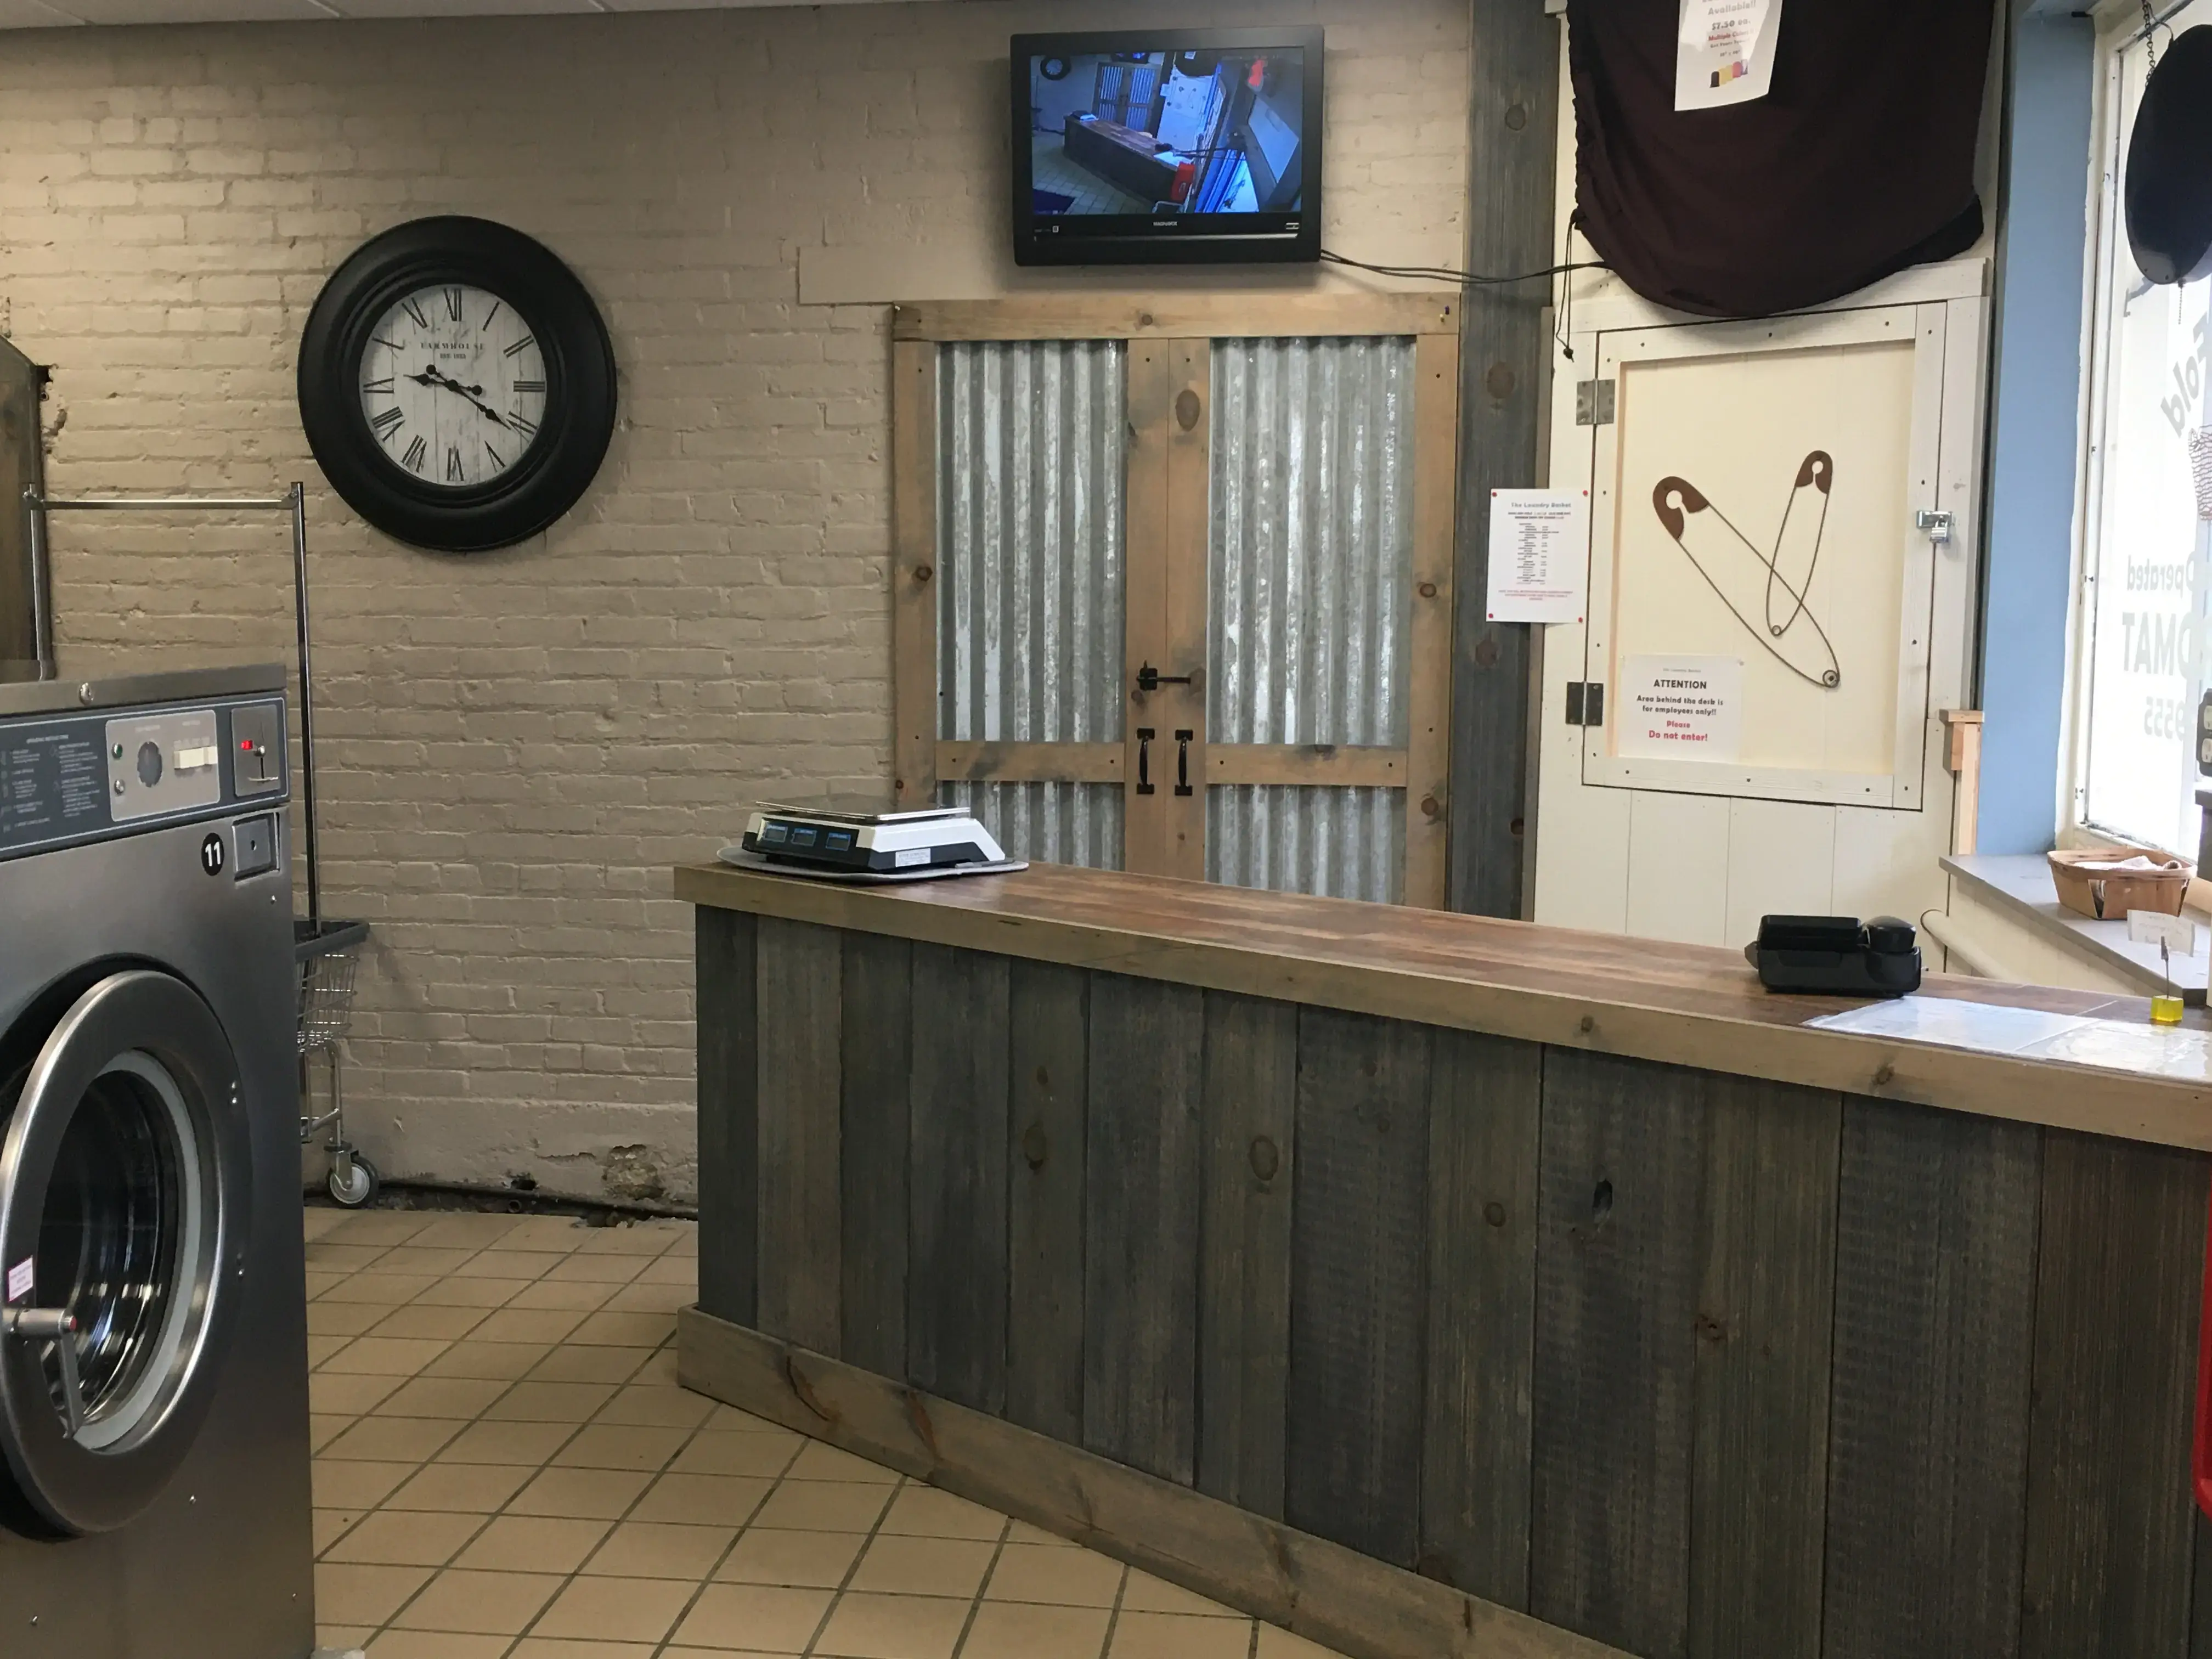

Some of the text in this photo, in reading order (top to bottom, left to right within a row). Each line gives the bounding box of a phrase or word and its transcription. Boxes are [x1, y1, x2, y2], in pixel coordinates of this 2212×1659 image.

[1712, 20, 1735, 31] $7.50
[1653, 679, 1707, 690] ATTENTION
[1656, 695, 1681, 704] behind
[1698, 697, 1716, 706] desk
[1655, 706, 1693, 715] employees
[1695, 708, 1717, 716] only!!
[1666, 720, 1691, 729] Please
[1649, 730, 1708, 741] Do not enter!
[205, 841, 221, 867] 11
